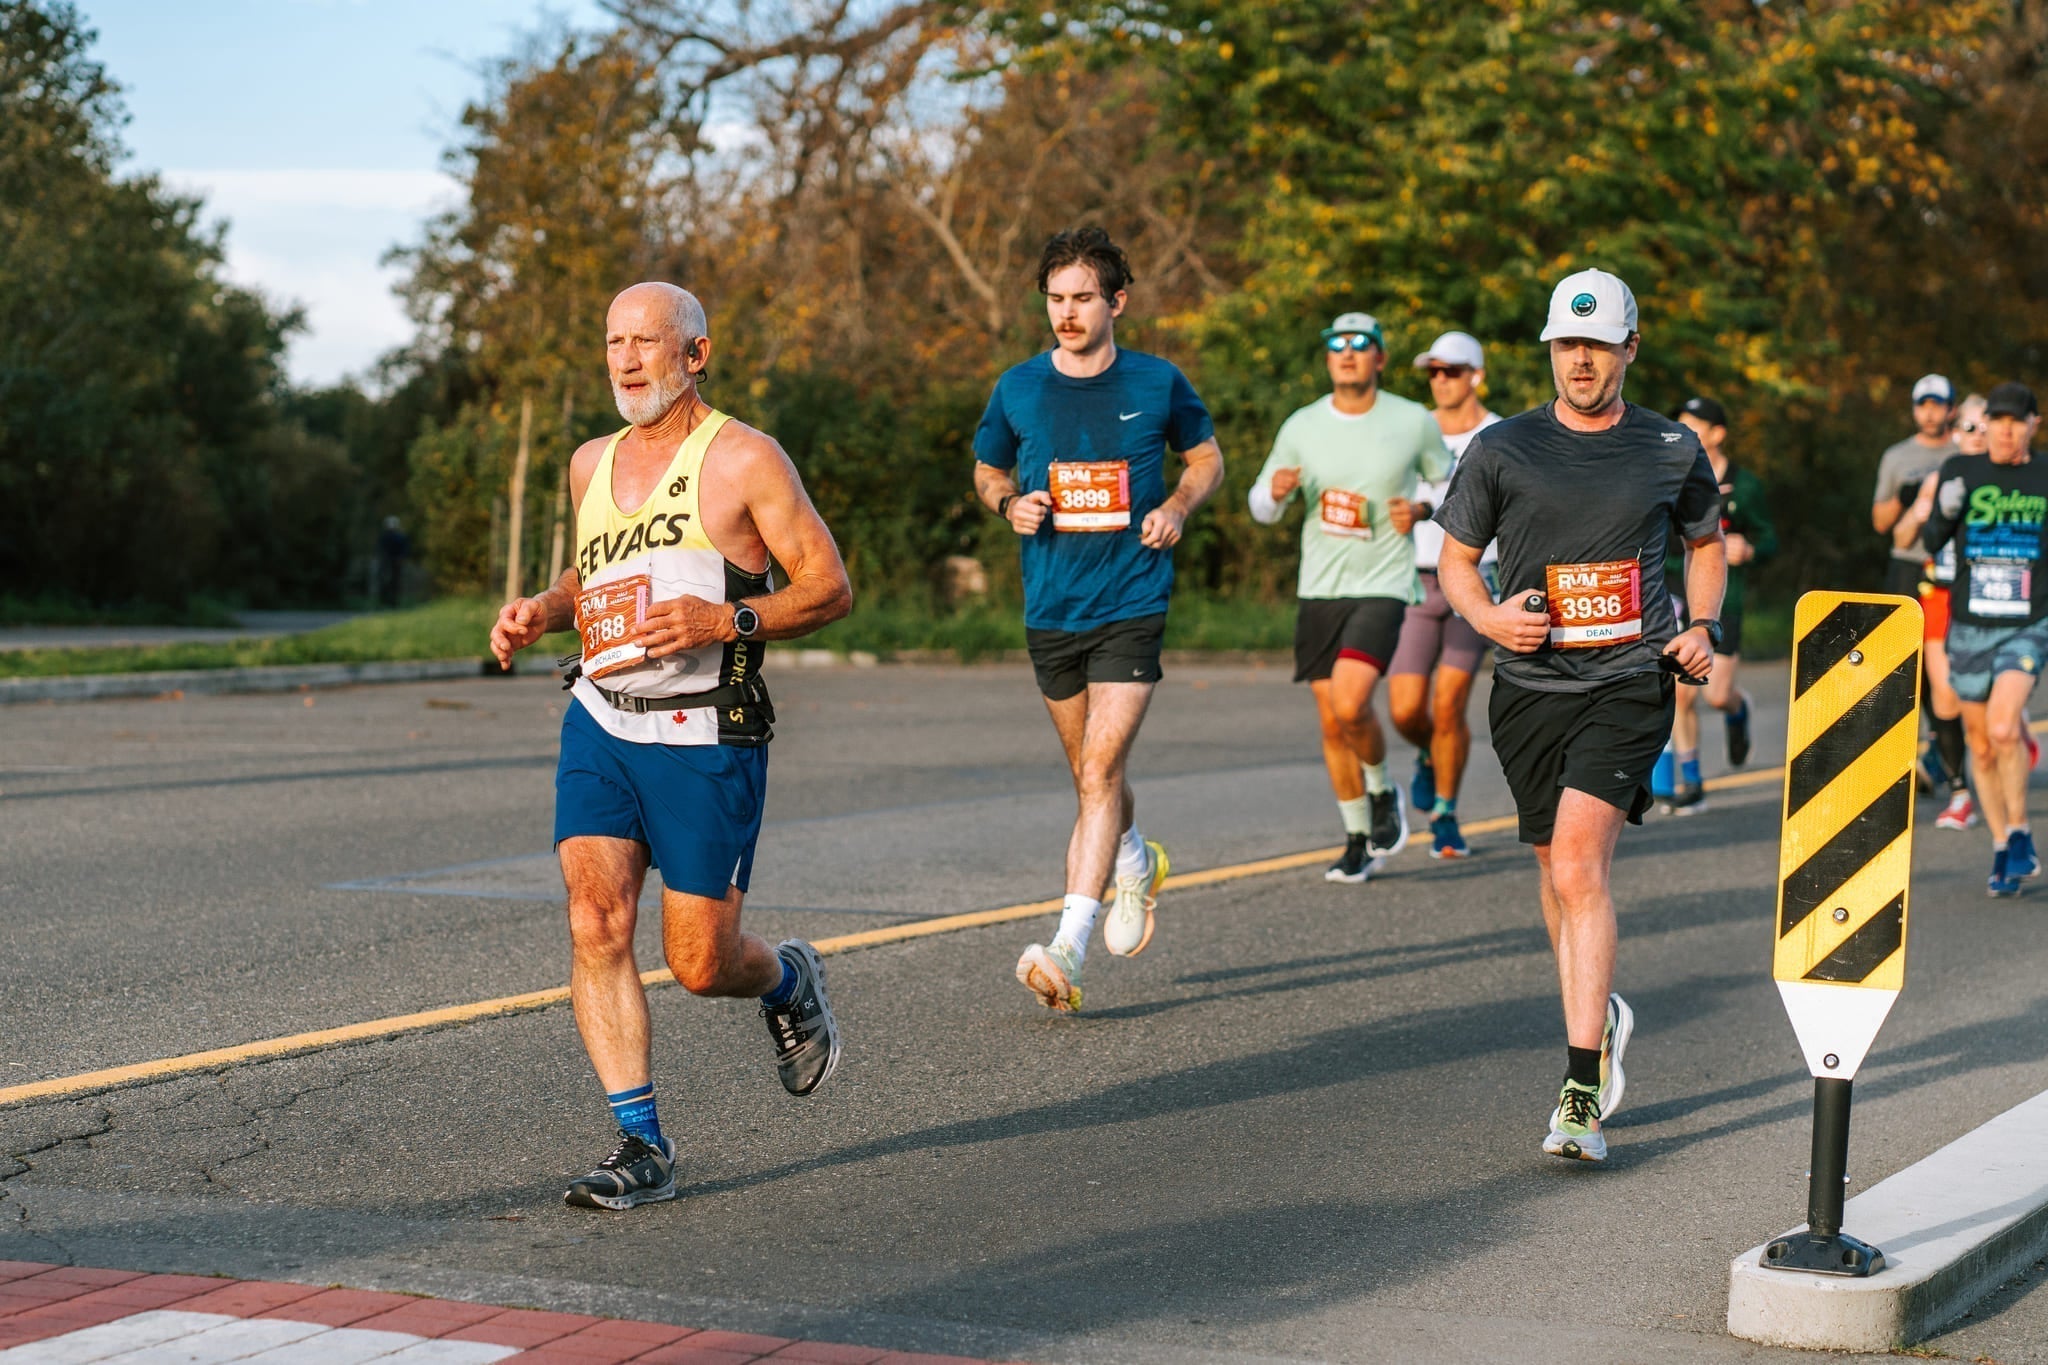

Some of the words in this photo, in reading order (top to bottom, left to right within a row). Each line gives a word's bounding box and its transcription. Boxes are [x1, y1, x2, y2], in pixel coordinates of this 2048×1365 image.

[1058, 469, 1091, 483] RVM
[1061, 489, 1110, 508] 3899
[1558, 572, 1598, 590] RVM
[581, 594, 607, 618] RVM
[1562, 595, 1621, 619] 3936
[587, 615, 625, 649] 3788
[1586, 628, 1613, 637] DEAN
